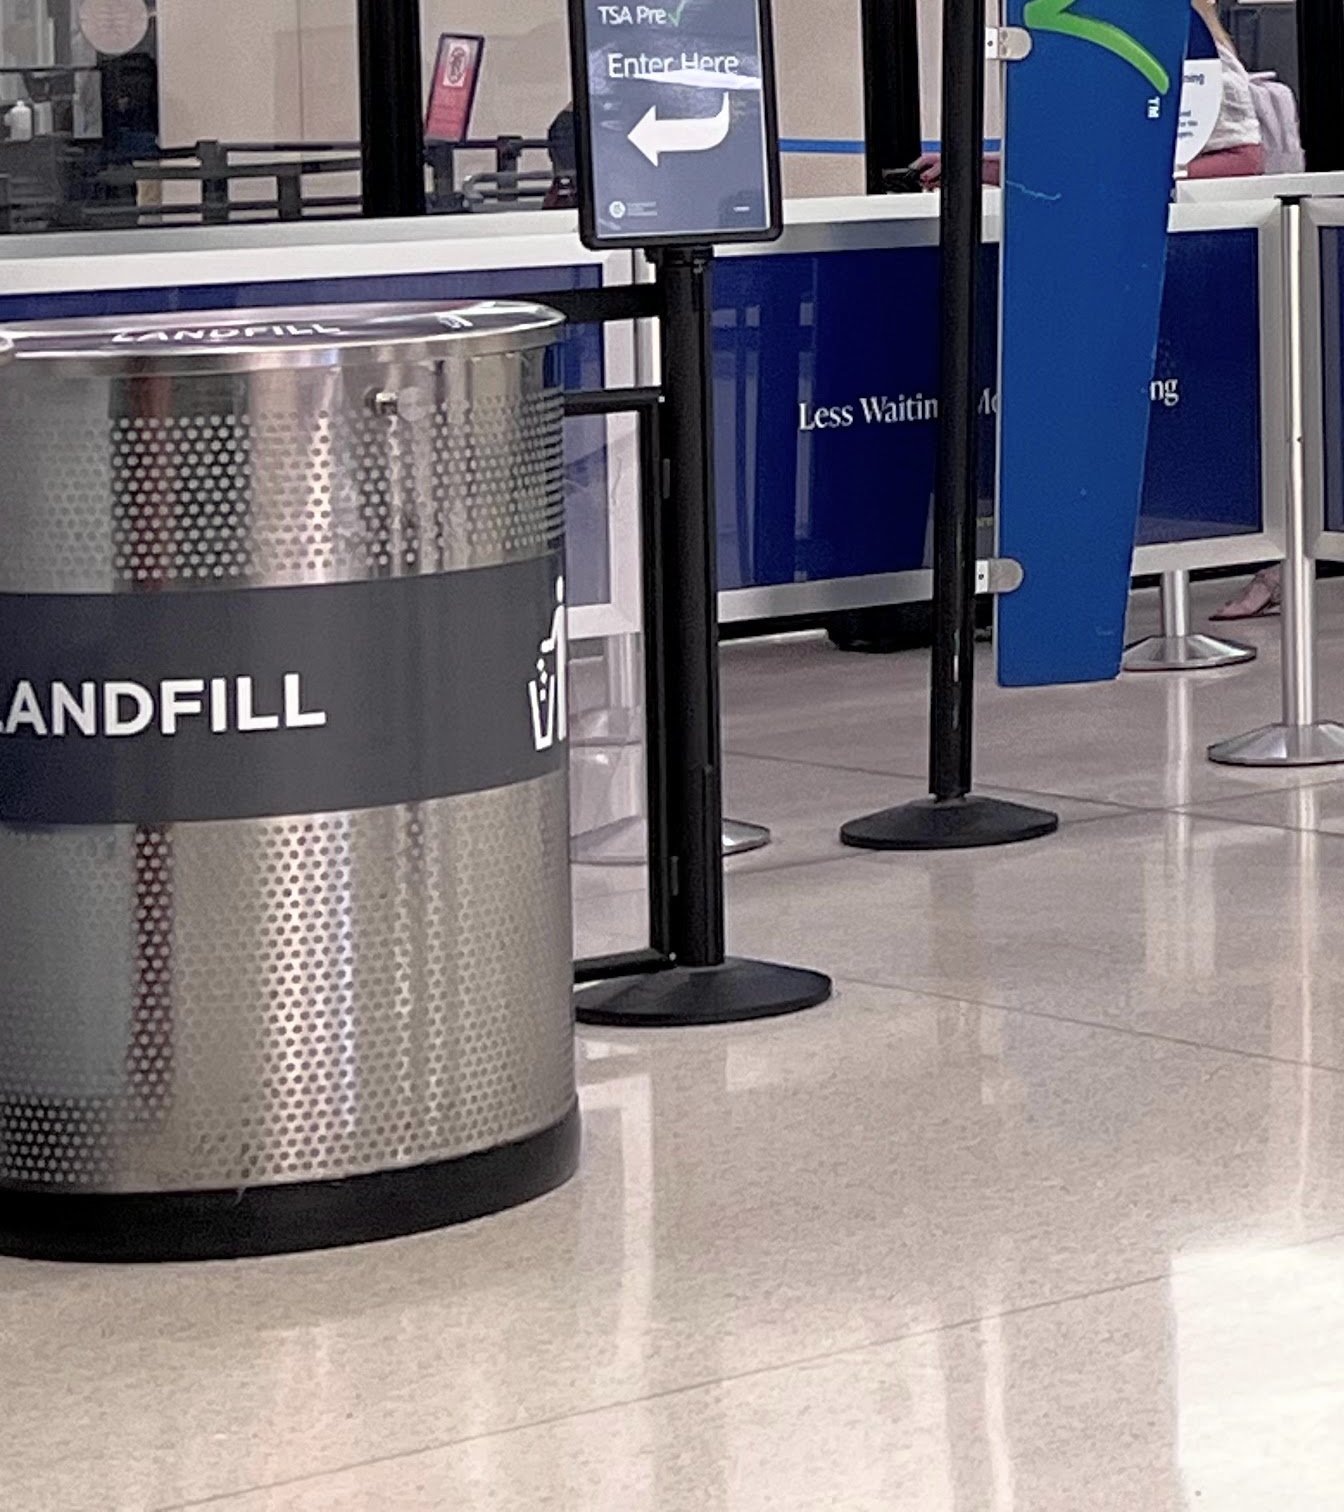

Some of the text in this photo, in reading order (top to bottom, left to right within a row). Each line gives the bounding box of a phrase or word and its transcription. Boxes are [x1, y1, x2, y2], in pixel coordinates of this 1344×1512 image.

[597, 4, 668, 25] TSA Pre
[607, 51, 740, 78] Enter Here
[111, 321, 342, 343] LANDFILL
[799, 393, 938, 431] Less Waitin
[0, 672, 327, 737] ANDFILL
